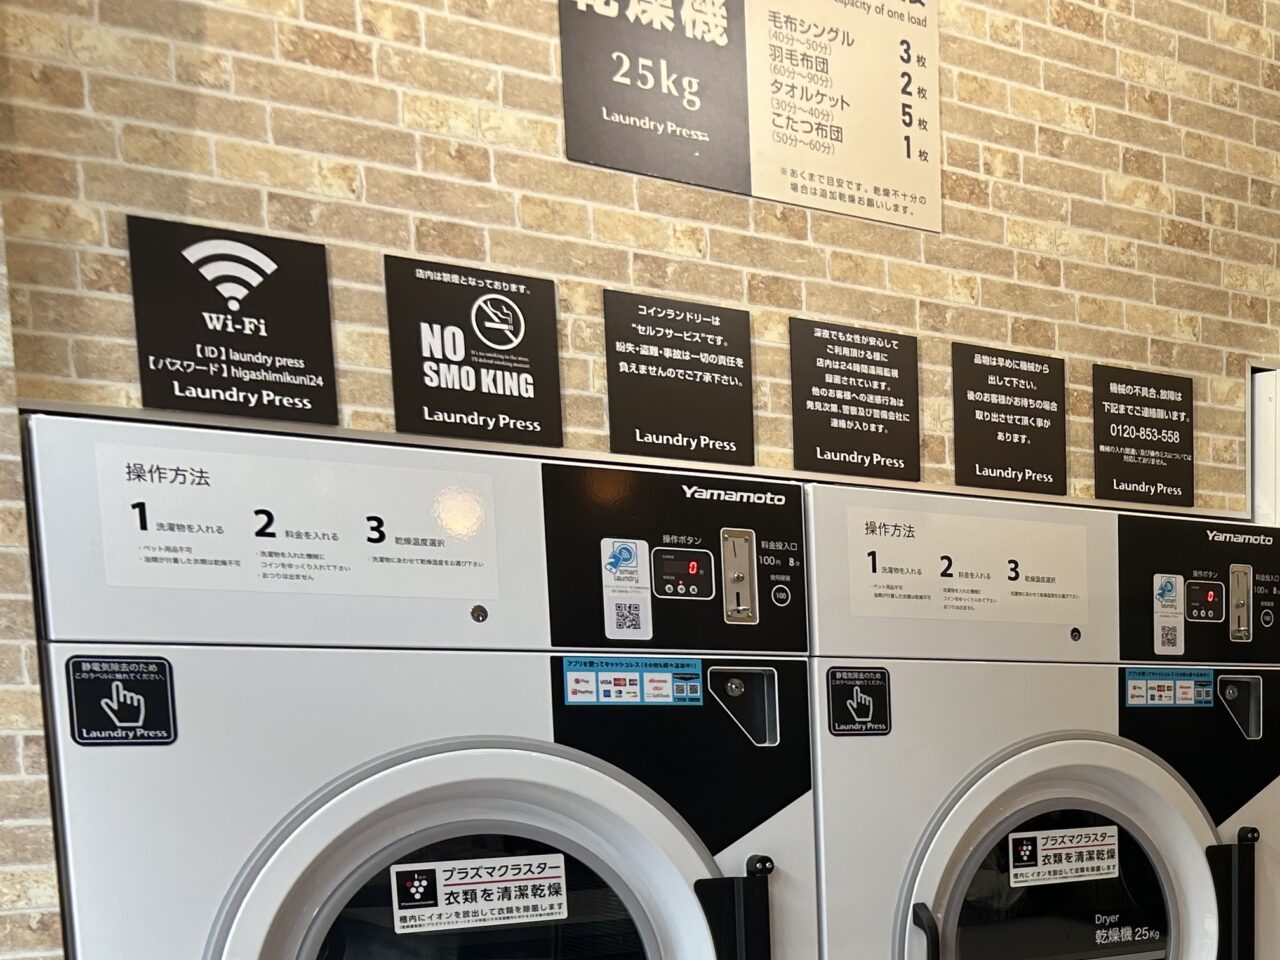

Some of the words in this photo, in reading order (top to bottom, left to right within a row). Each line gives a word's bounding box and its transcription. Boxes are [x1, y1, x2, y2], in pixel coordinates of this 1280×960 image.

[875, 4, 884, 16] of
[887, 9, 905, 21] one
[907, 11, 927, 28] load
[768, 10, 855, 47] 毛布シングル
[900, 39, 911, 64] 3
[769, 43, 829, 75] 羽毛布団
[901, 71, 912, 96] 2
[611, 51, 702, 111] 25kg
[771, 78, 850, 112] タオルケット
[902, 102, 913, 127] 5
[601, 106, 664, 135] Laundry
[667, 121, 710, 142] Press
[772, 111, 843, 143] こたつ布団
[415, 268, 532, 295] 店内は禁煙となっております。
[202, 311, 268, 337] Wi-Fi
[638, 304, 721, 326] コインランドリーは
[419, 321, 465, 361] NO
[229, 347, 273, 368] laundry
[275, 355, 305, 369] press
[615, 341, 744, 368] 紛失・盗難・事故は一切の責任を
[973, 353, 1050, 374] 品物は早めに機械から
[230, 365, 324, 387] higashimikuni24
[423, 360, 476, 392] SMO
[480, 367, 535, 399] KING
[619, 361, 744, 387] 負えませんのでご了承下さい。
[988, 374, 1037, 390] 出して下さい。
[172, 380, 258, 408] Laundry
[261, 388, 312, 410] Press
[423, 406, 495, 430] Laundry
[499, 414, 541, 432] Press
[975, 409, 1051, 428] 取り出させて頂く事が
[635, 428, 698, 450] Laundry
[700, 436, 737, 451] Press
[997, 431, 1031, 444] あります。
[1110, 423, 1180, 444] 0120-853-558
[816, 447, 871, 467] Laundry
[873, 453, 905, 468] Press
[125, 462, 211, 488] 操作方法
[975, 463, 1023, 482] Laundry
[1025, 469, 1053, 482] Press
[681, 485, 786, 506] Yamamoto
[1113, 478, 1155, 495] Laundry
[1157, 483, 1182, 496] Press
[130, 501, 149, 531] 1
[155, 521, 224, 535] 洗濯物を入れる
[253, 508, 277, 539] 2
[285, 530, 340, 542] 料金を入れる
[366, 516, 386, 544] 3
[662, 534, 702, 545] 操作ボタン
[864, 520, 916, 539] 操作方法
[1206, 529, 1273, 545] Yamamoto
[761, 540, 798, 551] 料金投入口
[689, 561, 697, 574] 0
[867, 550, 877, 574] 1
[940, 555, 954, 578] 2
[1007, 559, 1020, 581] 3
[82, 728, 134, 739] Laundry
[136, 728, 168, 738] Press
[835, 722, 866, 731] Laundry
[867, 722, 886, 730] Press
[1041, 832, 1116, 847] プラズマクラスター
[1041, 848, 1116, 866] 衣類を清潔乾燥
[442, 862, 561, 882] プラズマクラスター
[444, 883, 563, 906] 衣類を清潔乾燥
[1095, 914, 1120, 926] Dryer
[1095, 926, 1132, 945] 乾燥機
[1134, 927, 1160, 940] 25Kg
